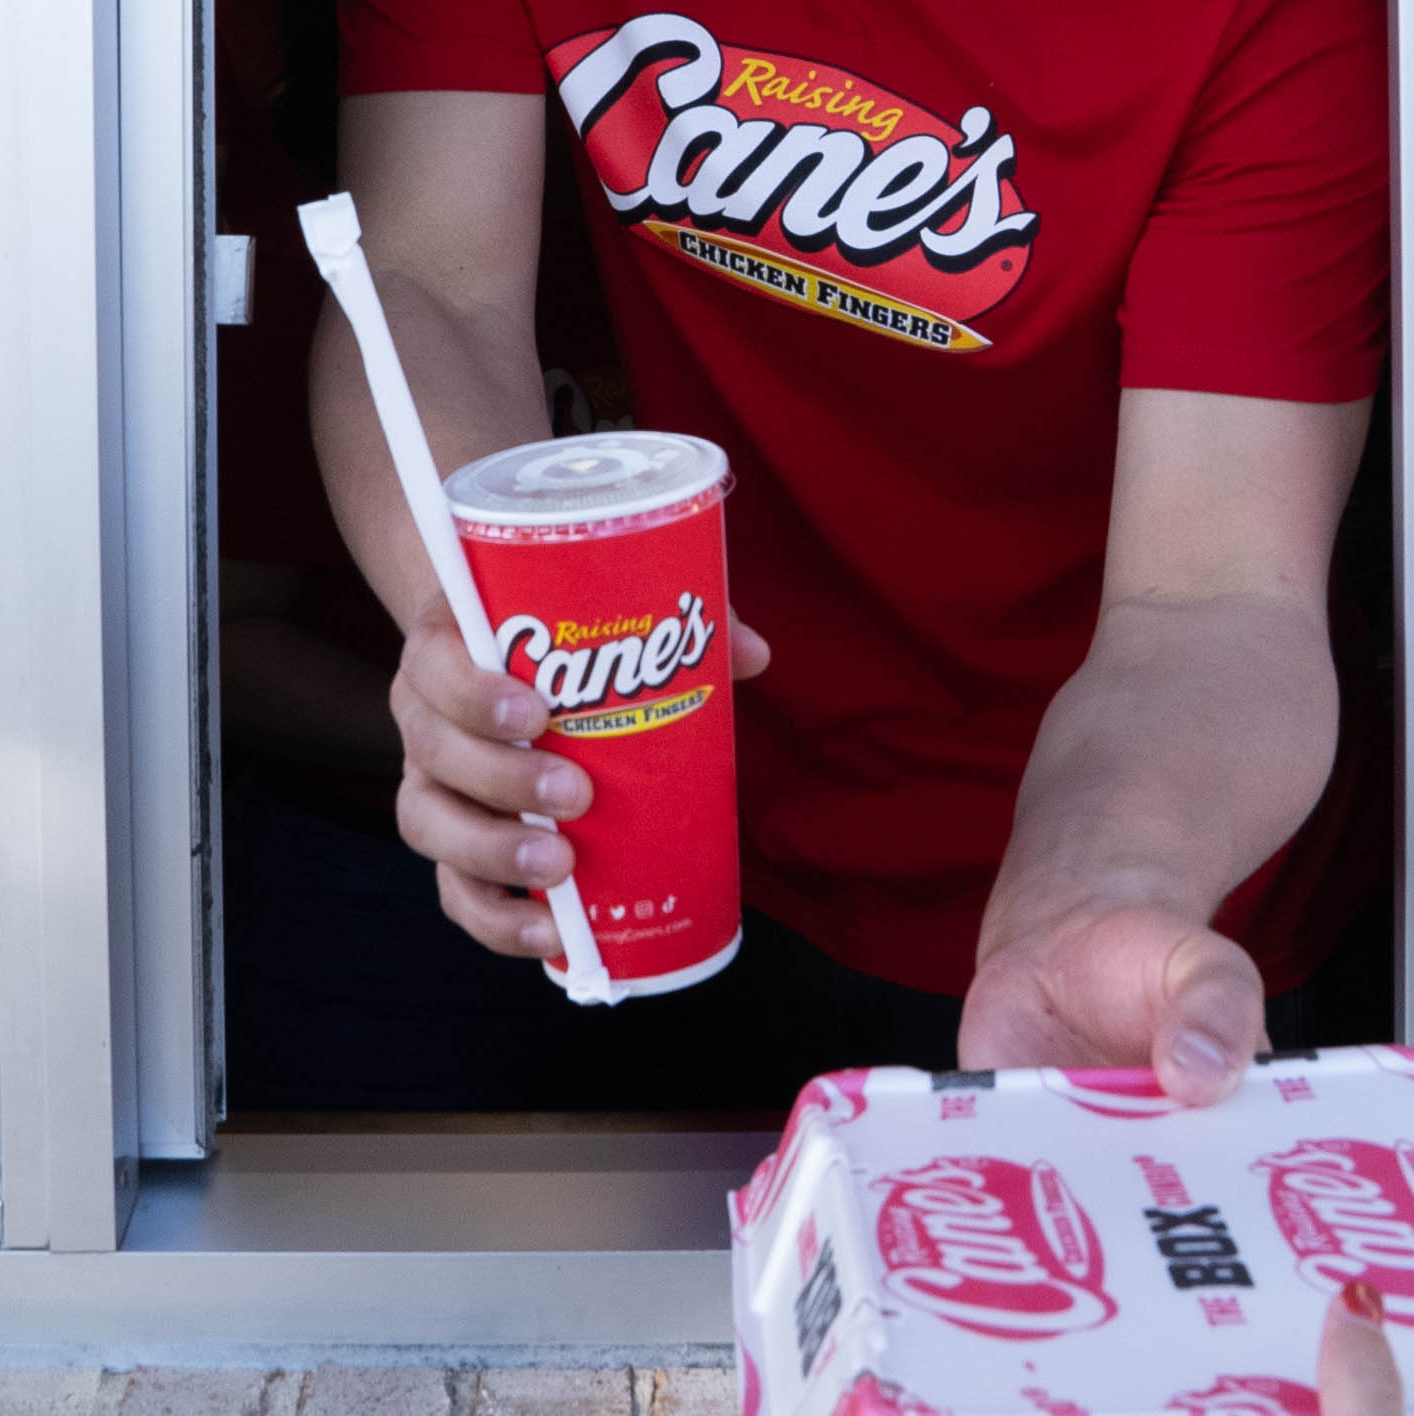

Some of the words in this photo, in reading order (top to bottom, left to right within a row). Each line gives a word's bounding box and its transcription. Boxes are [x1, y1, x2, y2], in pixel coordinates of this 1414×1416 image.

[558, 11, 1040, 273] Cane's
[724, 58, 904, 142] Raising
[678, 230, 806, 297] CHICKEN
[817, 278, 950, 348] FINGERS
[555, 614, 653, 646] Raising
[562, 709, 636, 733] CHICKEN
[1143, 1204, 1255, 1290] BOX
